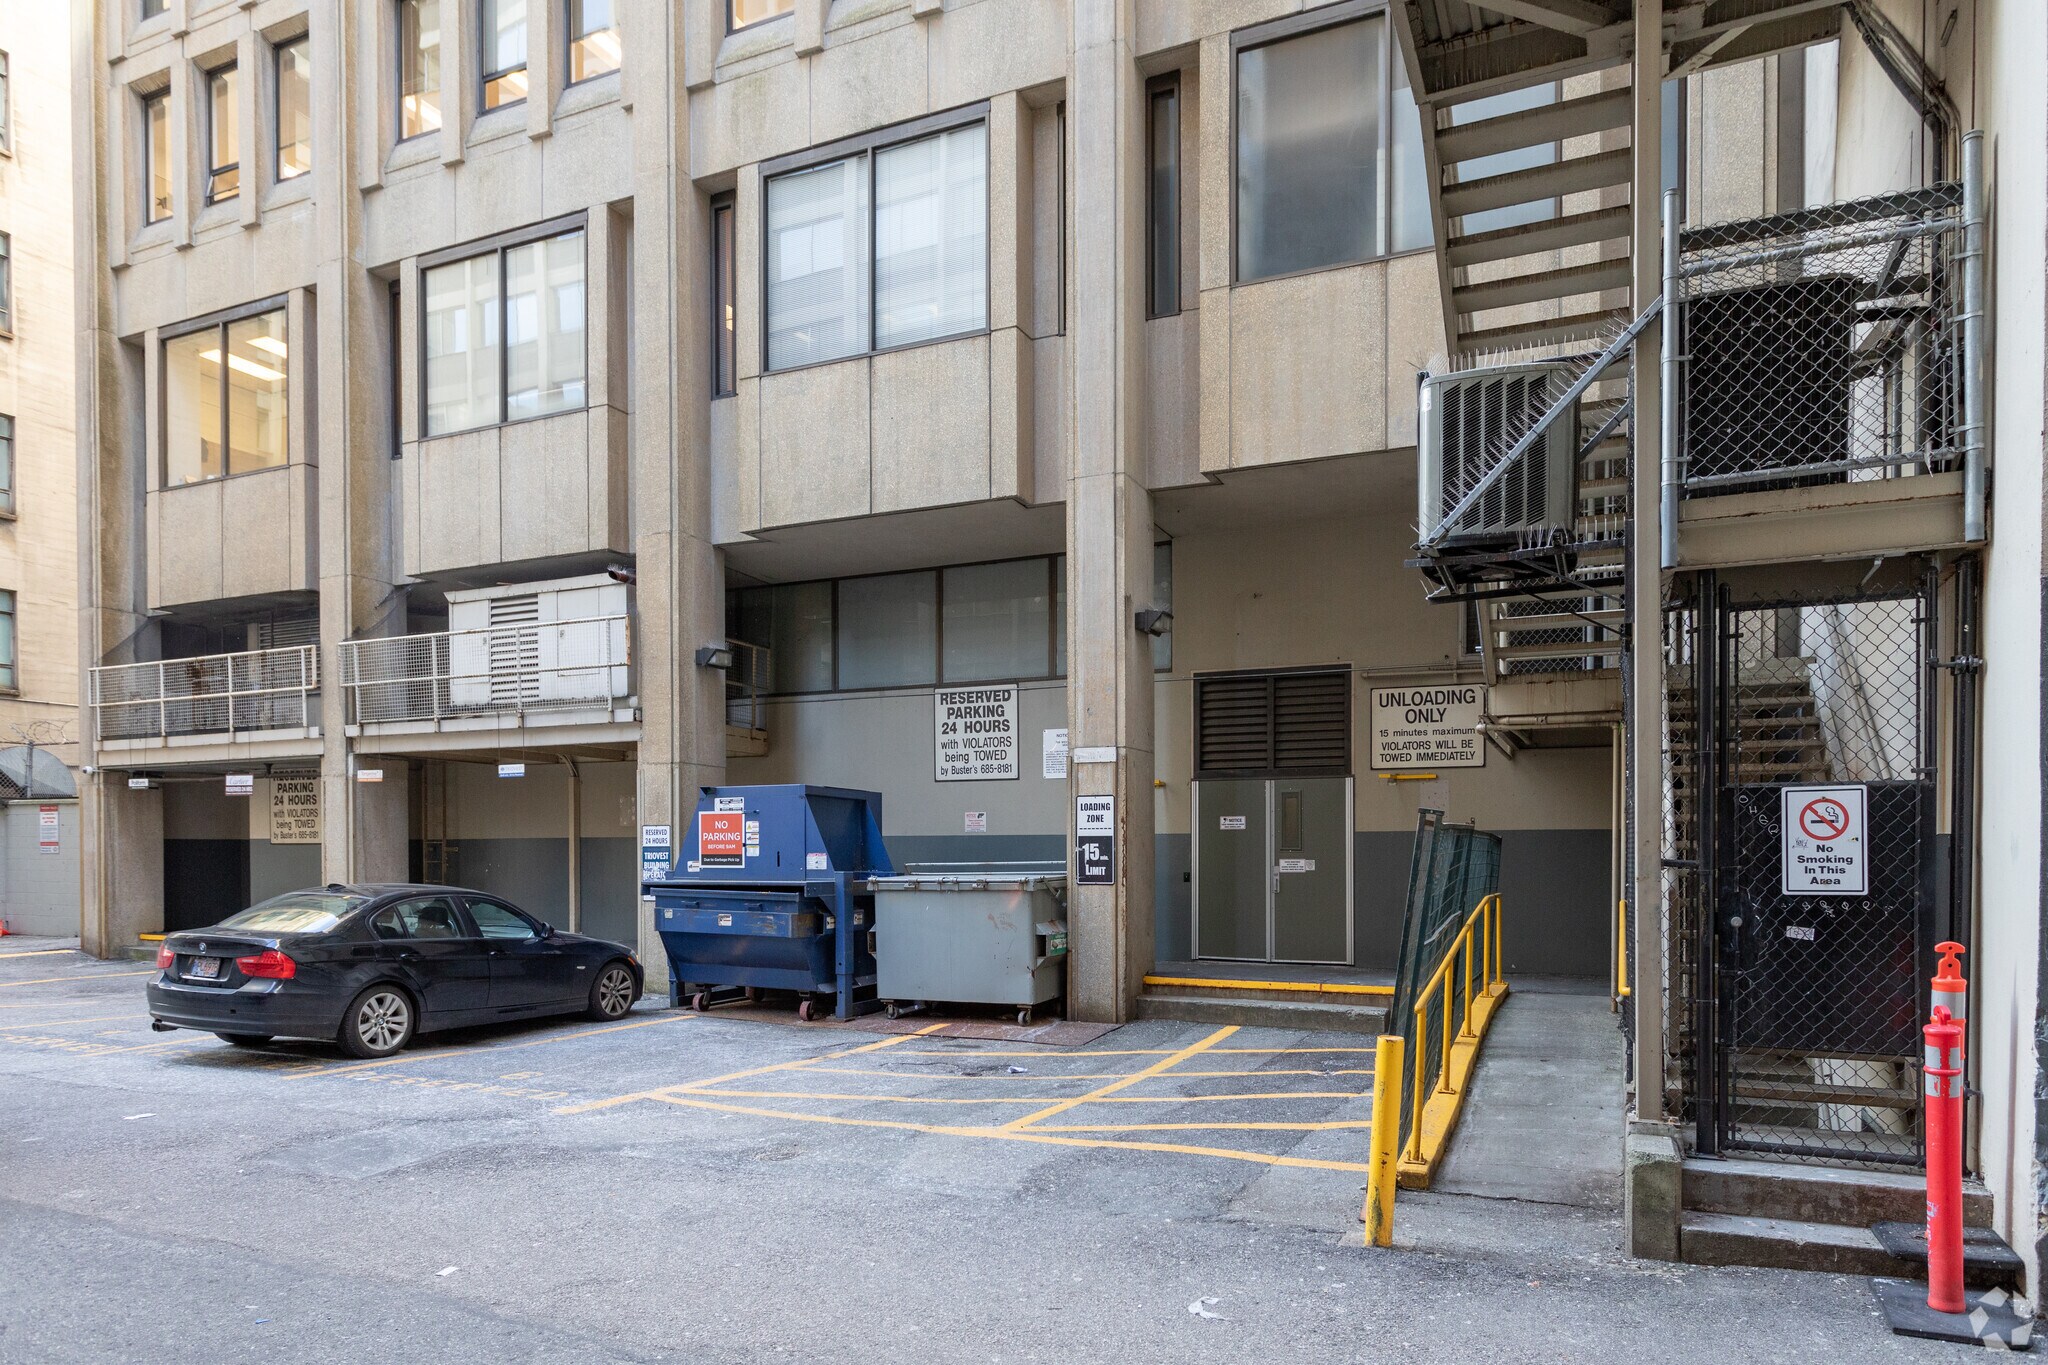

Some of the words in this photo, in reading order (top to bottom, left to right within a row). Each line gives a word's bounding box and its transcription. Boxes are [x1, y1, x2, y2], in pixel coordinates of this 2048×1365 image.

[940, 690, 1011, 705] RESERVED
[1380, 689, 1476, 707] UNLOADING
[947, 704, 1004, 719] PARKING
[1405, 708, 1447, 724] ONLY
[942, 722, 957, 734] 24
[964, 719, 1010, 733] HOURS
[1393, 729, 1428, 737] minutes
[1432, 727, 1475, 736] maximum
[941, 739, 958, 749] with
[962, 736, 1012, 748] VIOLATORS
[1382, 741, 1431, 751] VIOLATORS
[1435, 740, 1457, 749] WILL
[1461, 740, 1473, 748] BE
[945, 752, 969, 764] being
[974, 750, 1007, 761] TOWED
[1380, 753, 1412, 762] TOWED
[1416, 751, 1475, 761] IMMEDIATELY
[941, 766, 948, 776] by
[952, 765, 978, 774] Buster's
[981, 764, 1012, 774] 685-8181
[277, 782, 314, 793] PARKING
[274, 795, 284, 806] 24
[288, 795, 317, 805] HOURS
[273, 809, 285, 818] with
[287, 808, 318, 818] VIOLATORS
[1081, 803, 1111, 812] LOADING
[276, 820, 292, 830] being
[294, 819, 315, 828] TOWED
[1087, 815, 1104, 823] ZONE
[715, 821, 728, 829] NO
[1082, 843, 1100, 861] 15
[1816, 844, 1833, 853] No
[644, 852, 669, 860] TRIOVEST
[1797, 855, 1854, 865] Smoking
[1086, 863, 1106, 876] LIMIT
[1804, 866, 1816, 874] In
[1818, 866, 1846, 874] This
[1810, 877, 1841, 885] Area
